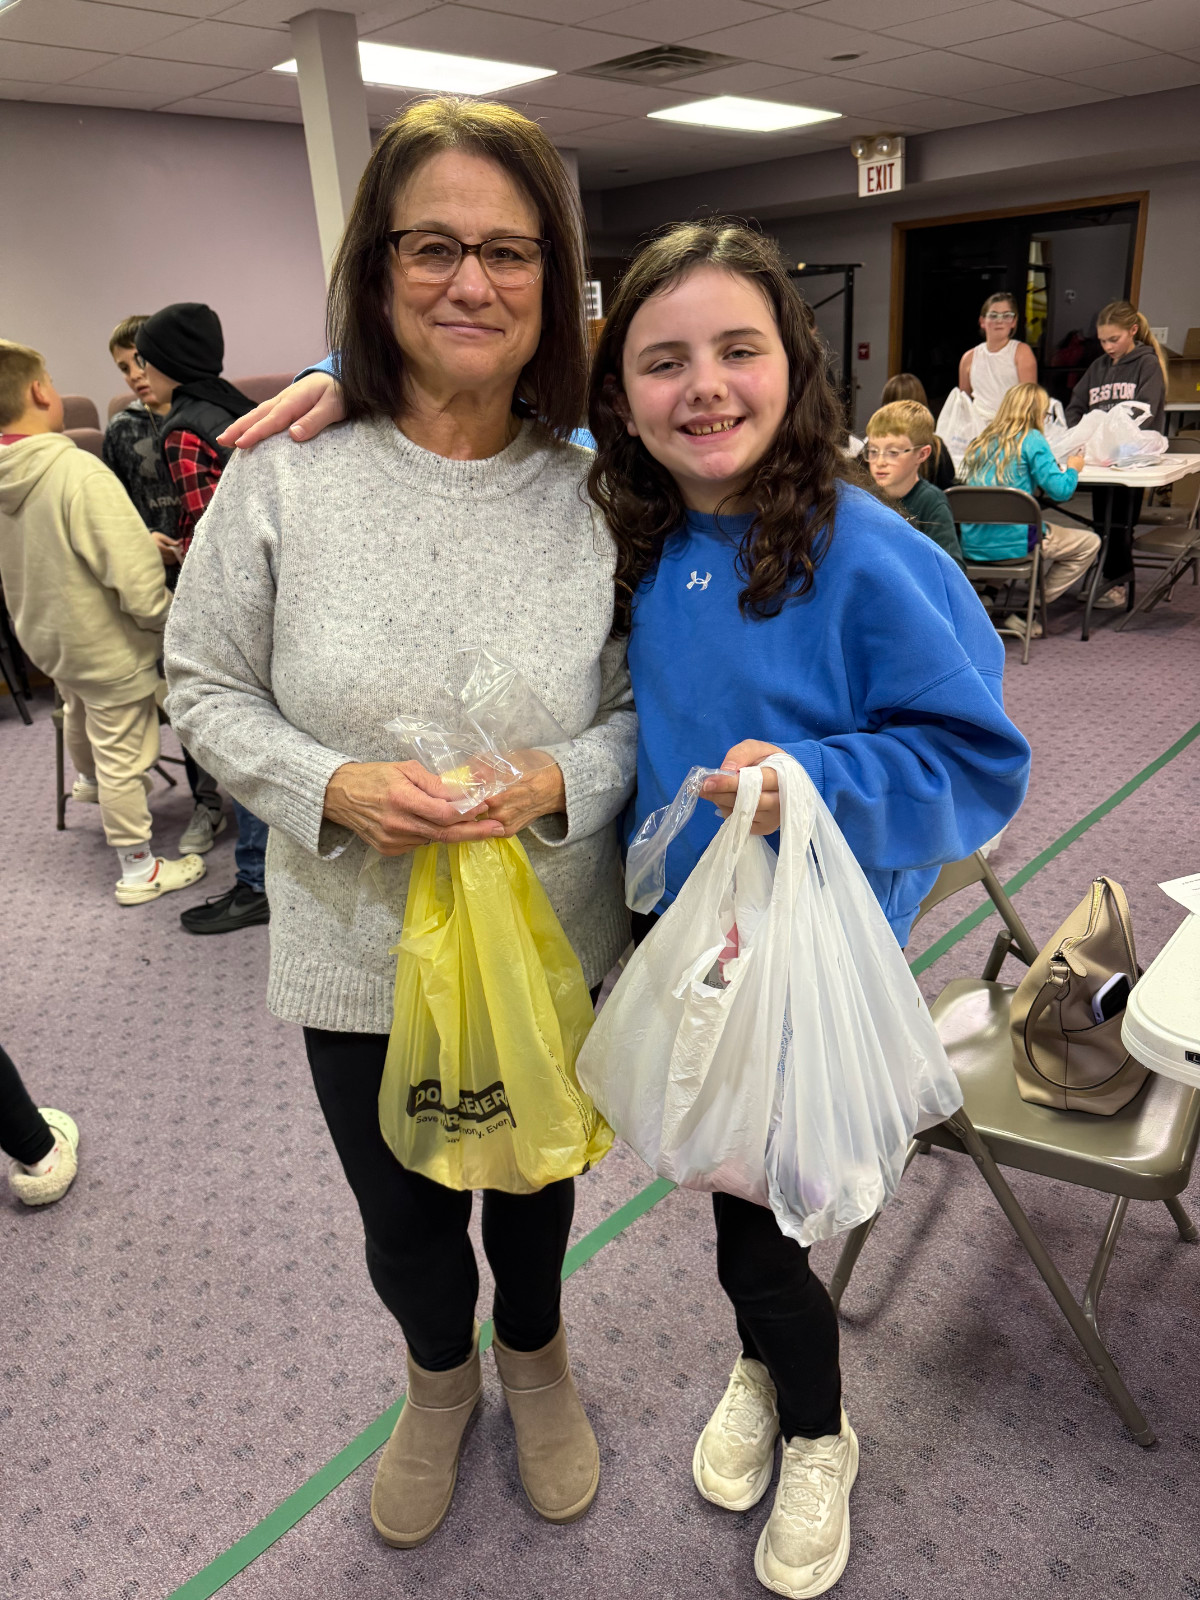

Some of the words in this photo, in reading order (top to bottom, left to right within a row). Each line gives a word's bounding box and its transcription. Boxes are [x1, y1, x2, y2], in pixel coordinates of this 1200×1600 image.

[867, 162, 895, 193] EXIT
[149, 496, 182, 509] ARM
[416, 1115, 438, 1124] Save
